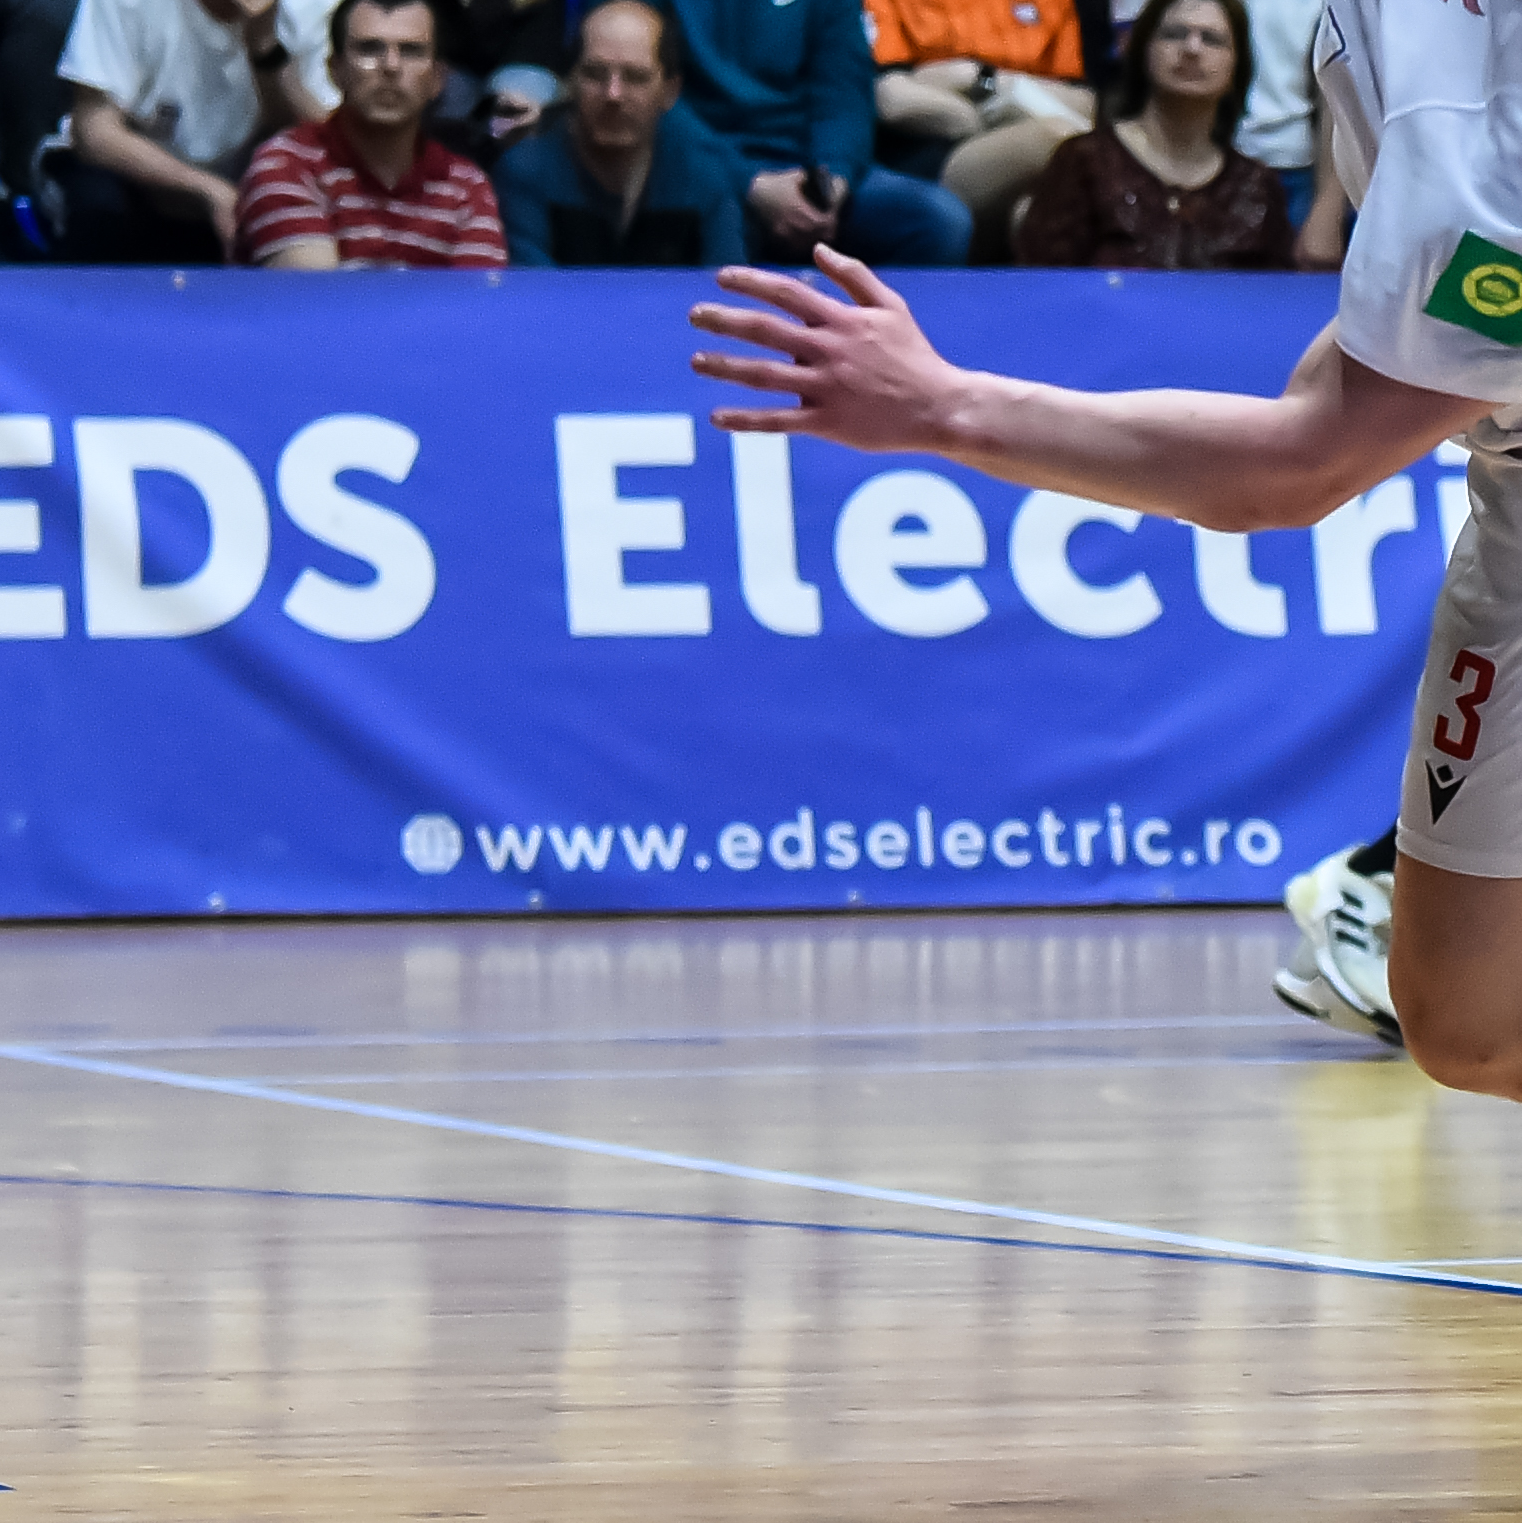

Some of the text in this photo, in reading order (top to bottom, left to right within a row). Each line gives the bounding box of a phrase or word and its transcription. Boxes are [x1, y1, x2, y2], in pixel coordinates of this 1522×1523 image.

[555, 413, 1471, 638] Electri
[1434, 649, 1496, 761] 3
[476, 806, 1281, 872] www.edselectric.ro
